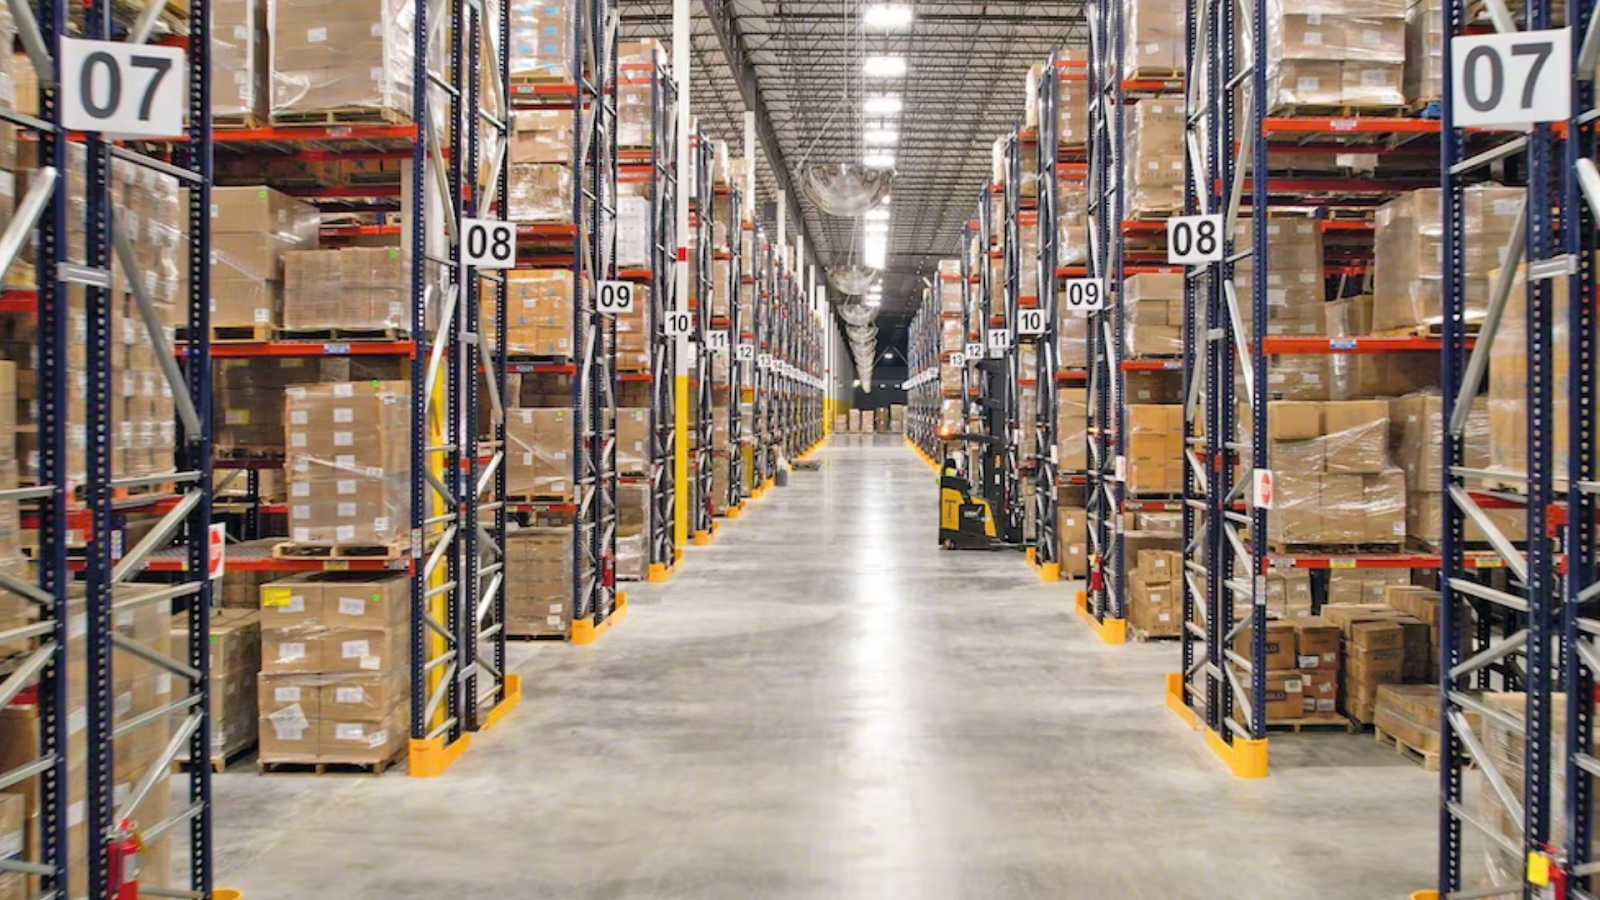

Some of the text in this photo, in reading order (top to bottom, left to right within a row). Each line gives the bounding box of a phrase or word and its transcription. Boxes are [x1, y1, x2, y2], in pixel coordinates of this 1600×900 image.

[79, 51, 173, 122] 07
[1462, 41, 1554, 113] 07
[467, 224, 511, 261] 08
[1172, 220, 1217, 257] 08
[600, 284, 631, 309] 09
[1069, 282, 1099, 307] 09
[669, 314, 689, 333] 10
[1022, 312, 1042, 331] 10
[710, 333, 725, 347] 11
[992, 331, 1007, 346] 11
[739, 346, 753, 359] 12
[760, 355, 772, 366] 13
[952, 354, 964, 366] 13
[968, 344, 982, 358] 12
